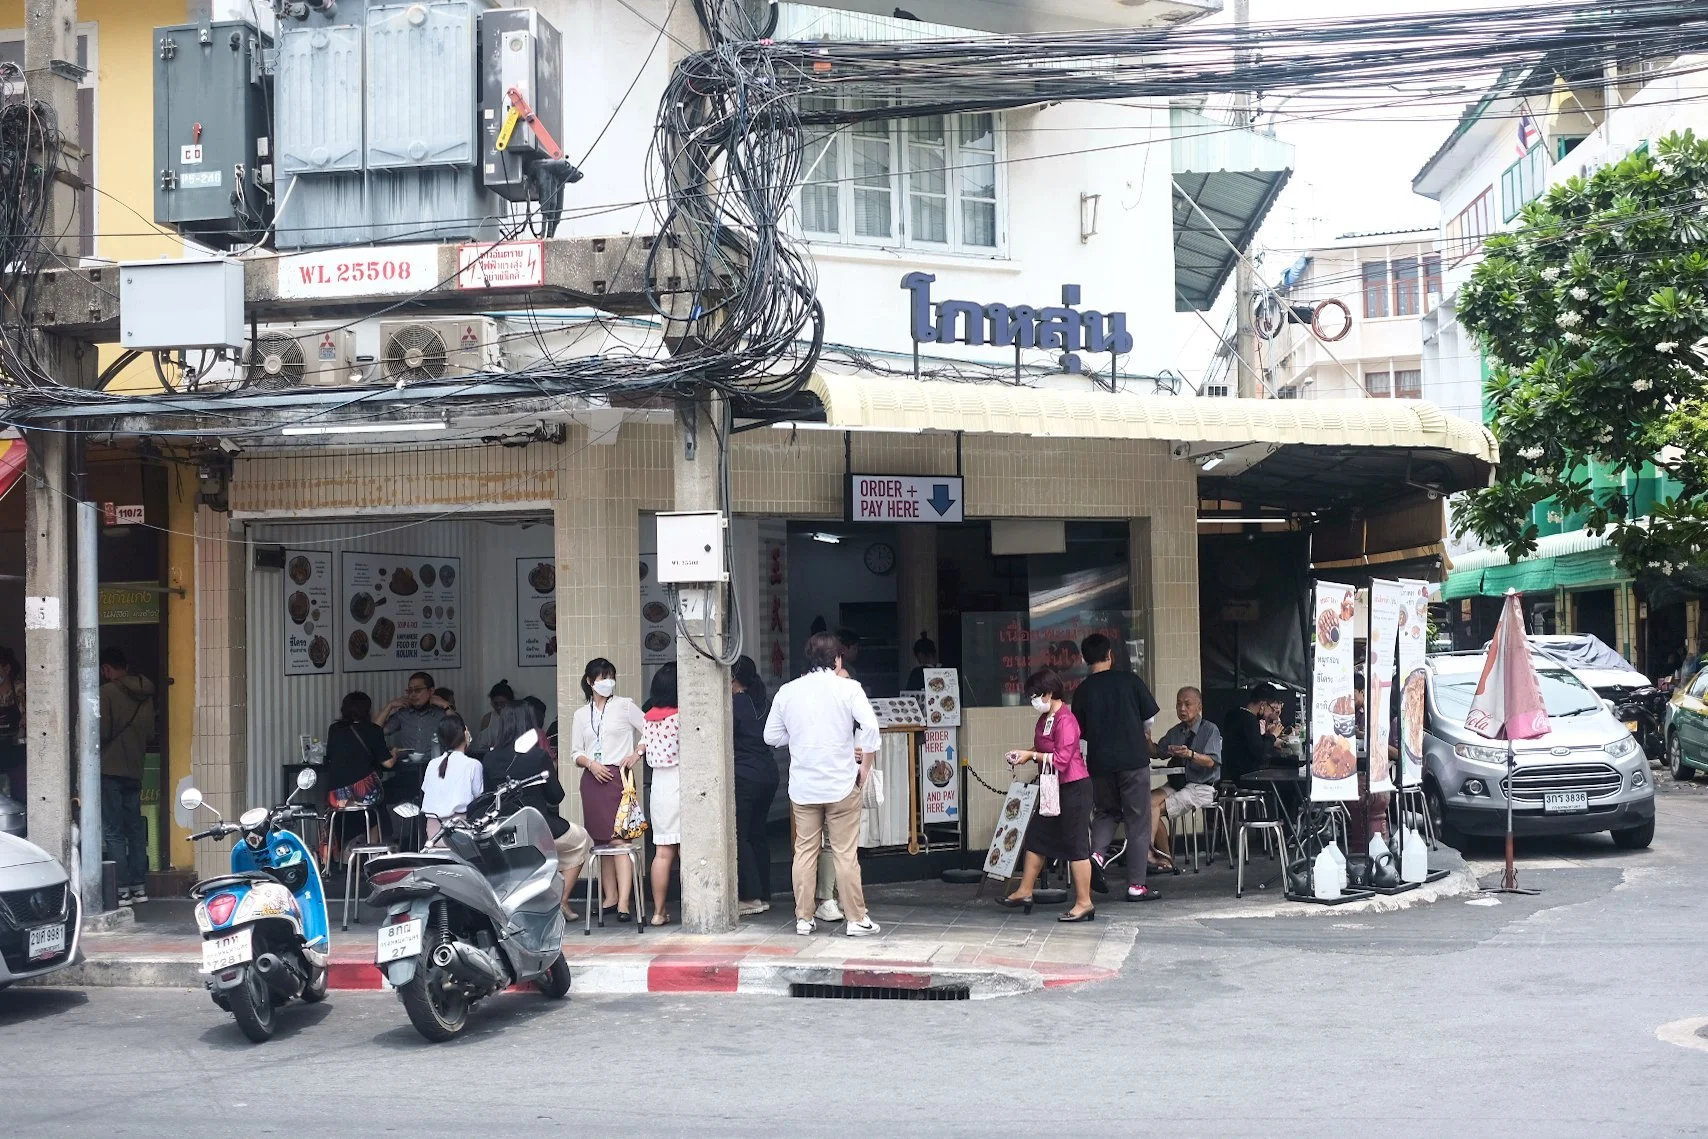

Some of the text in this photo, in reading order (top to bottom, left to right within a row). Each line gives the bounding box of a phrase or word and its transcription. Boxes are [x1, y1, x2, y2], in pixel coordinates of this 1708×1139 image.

[298, 260, 411, 285] WL 25508
[900, 271, 1133, 374] โกหลุ่น
[860, 480, 902, 498] ORDER
[118, 508, 143, 518] 110/2
[861, 500, 920, 518] PAY HERE
[924, 730, 949, 742] ORDER
[924, 742, 944, 753] HERE
[926, 790, 955, 802] AND PAY
[1565, 793, 1586, 802] 3836
[926, 802, 945, 814] HERE
[391, 945, 407, 958] 27
